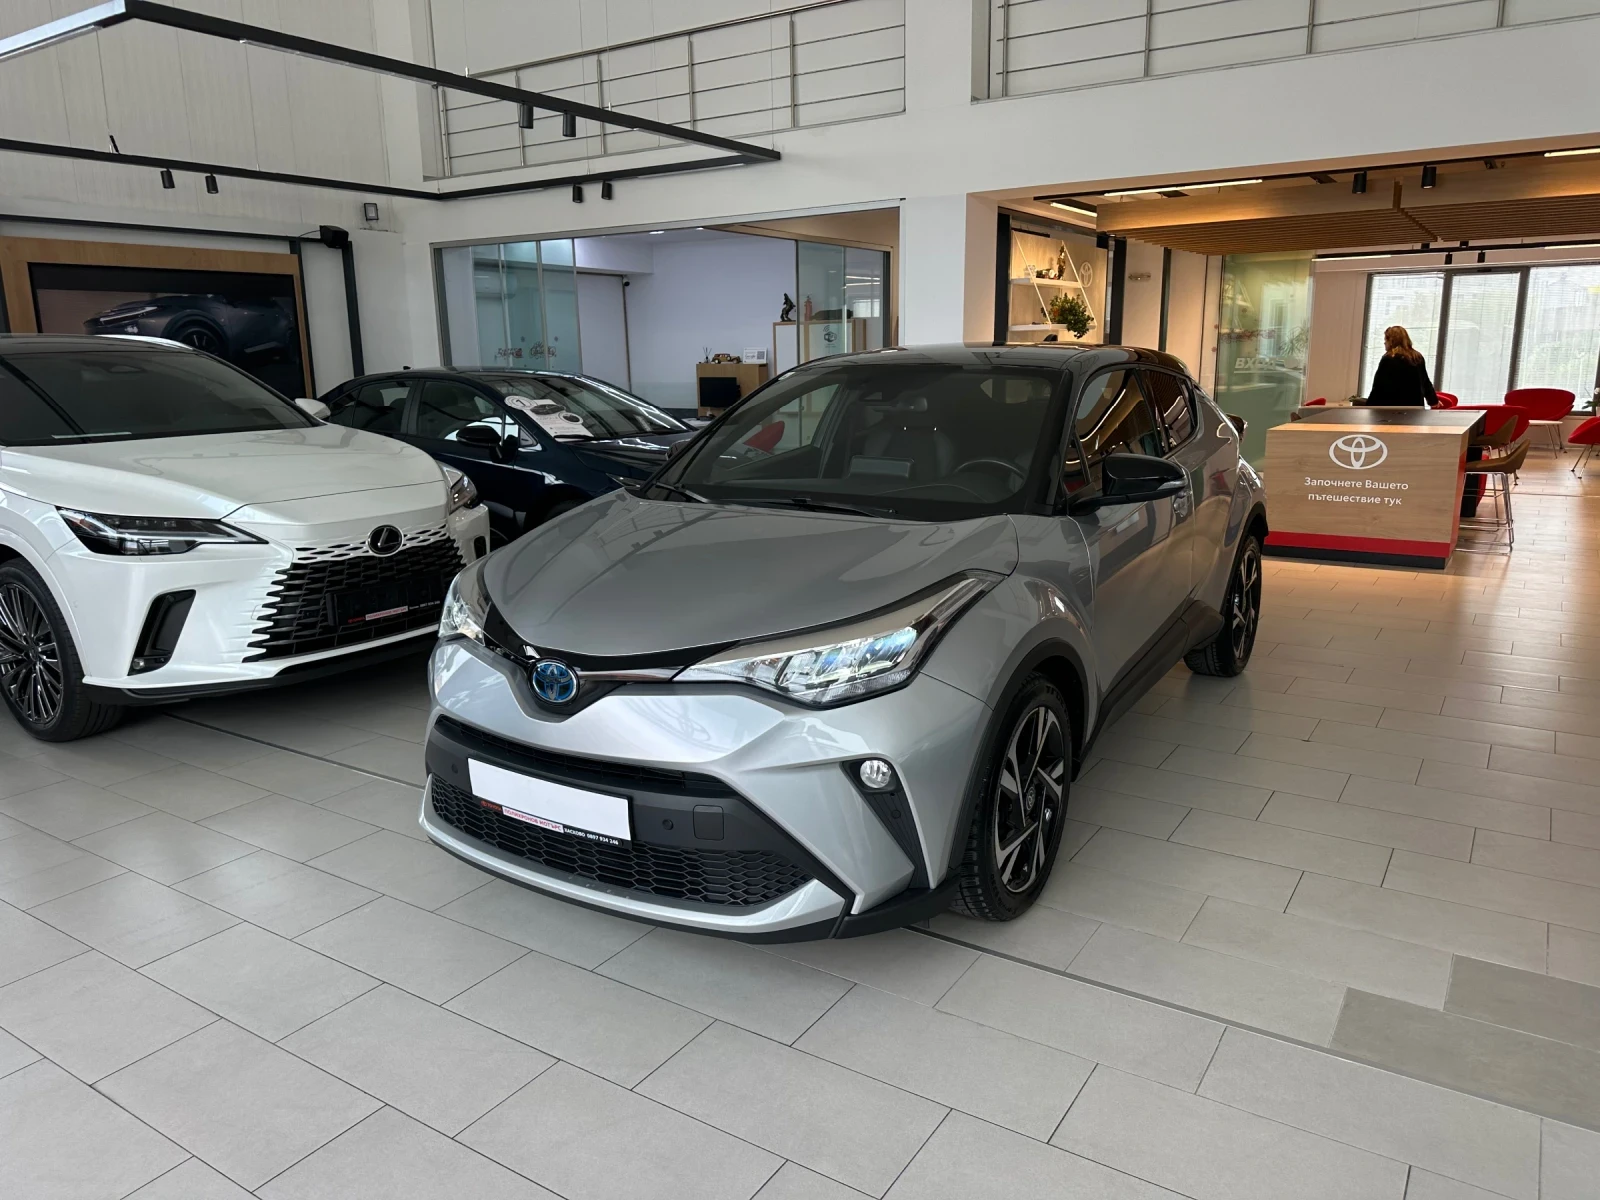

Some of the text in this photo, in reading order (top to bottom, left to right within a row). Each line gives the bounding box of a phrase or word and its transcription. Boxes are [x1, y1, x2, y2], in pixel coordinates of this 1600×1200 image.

[1304, 477, 1409, 490] Започнете Вашето
[1308, 493, 1402, 507] пътешествие тук
